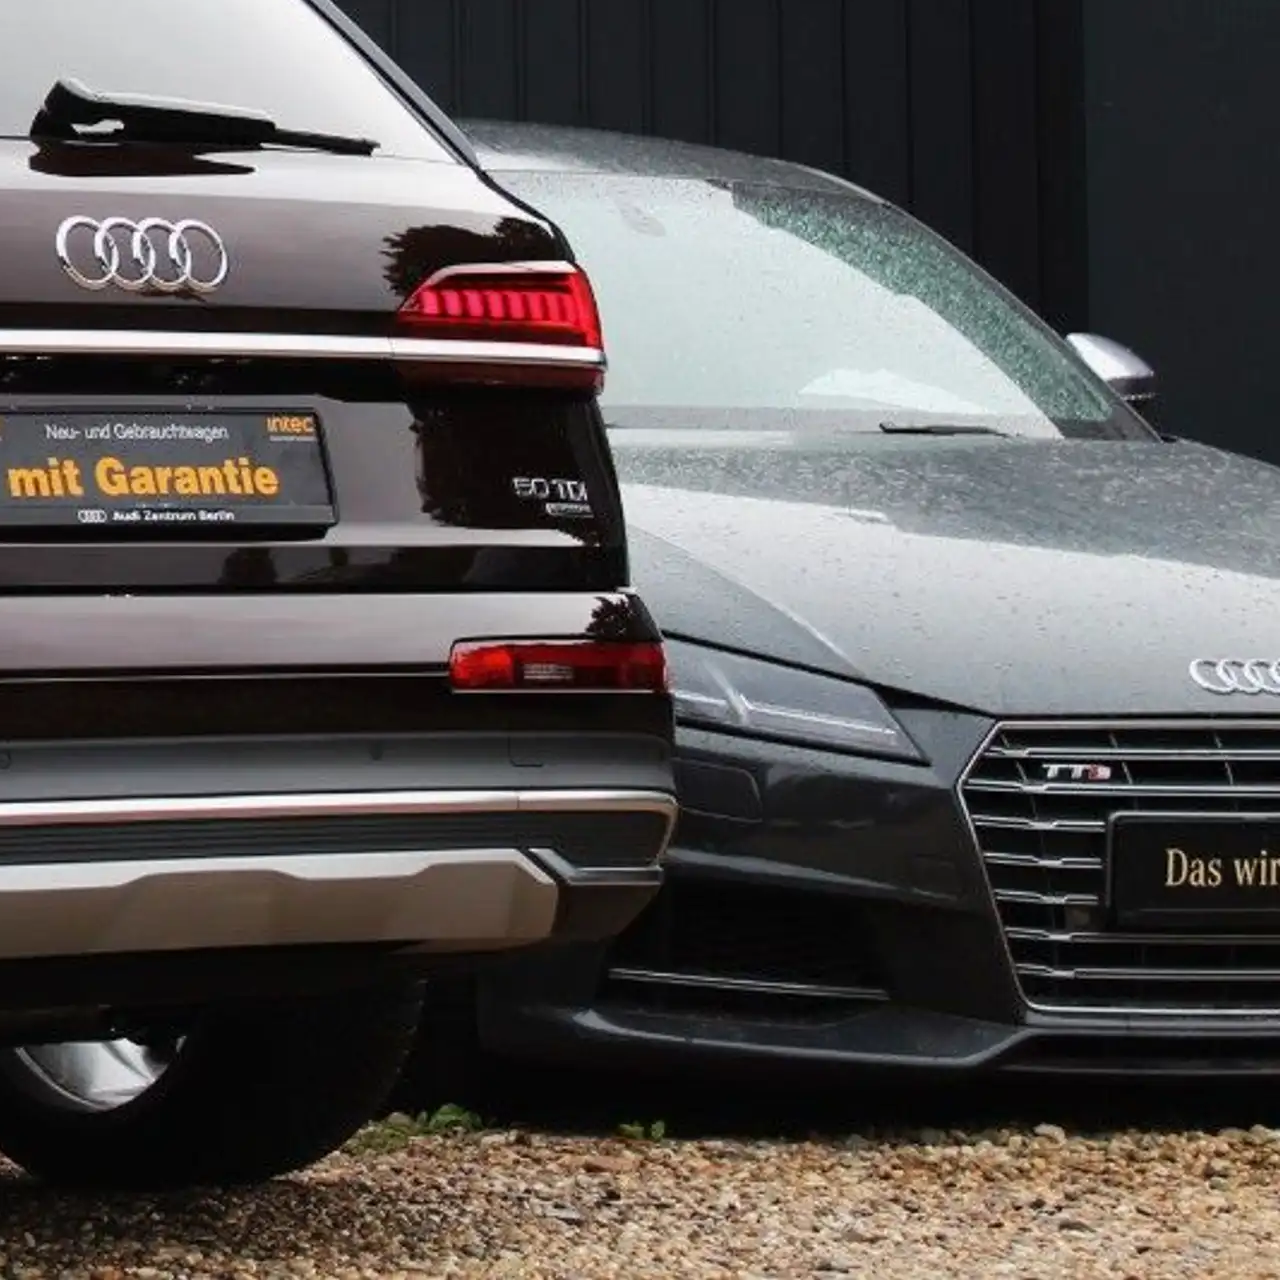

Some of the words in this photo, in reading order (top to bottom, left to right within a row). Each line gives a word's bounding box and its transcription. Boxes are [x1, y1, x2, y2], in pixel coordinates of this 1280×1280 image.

[85, 423, 111, 439] und
[113, 422, 229, 443] Gebrauchtwagen
[8, 456, 84, 498] mit
[94, 456, 281, 498] Garantie
[112, 510, 141, 522] Audi
[143, 510, 197, 522] Zentrum
[198, 510, 235, 522] Berlin
[1165, 848, 1222, 887] Das
